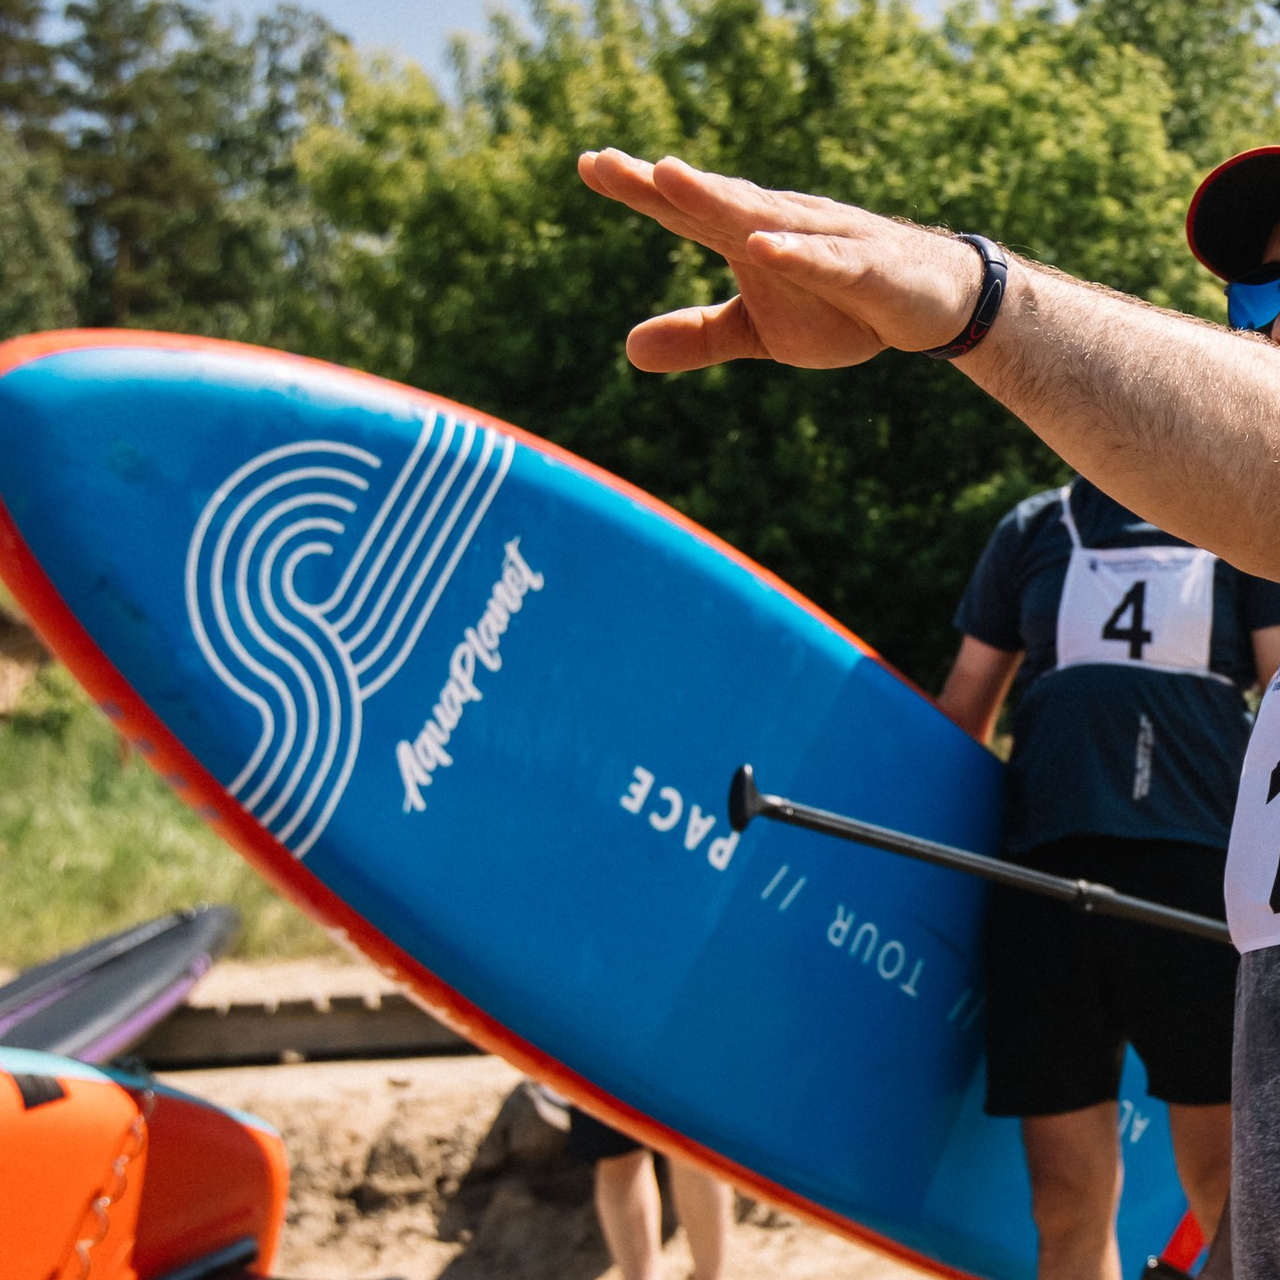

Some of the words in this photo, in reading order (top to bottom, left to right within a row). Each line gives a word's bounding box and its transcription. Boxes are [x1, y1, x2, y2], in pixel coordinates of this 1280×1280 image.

[1102, 580, 1153, 660] 4
[396, 535, 545, 813] AquaPlanet
[619, 765, 741, 872] PACE
[826, 904, 925, 999] TOUR
